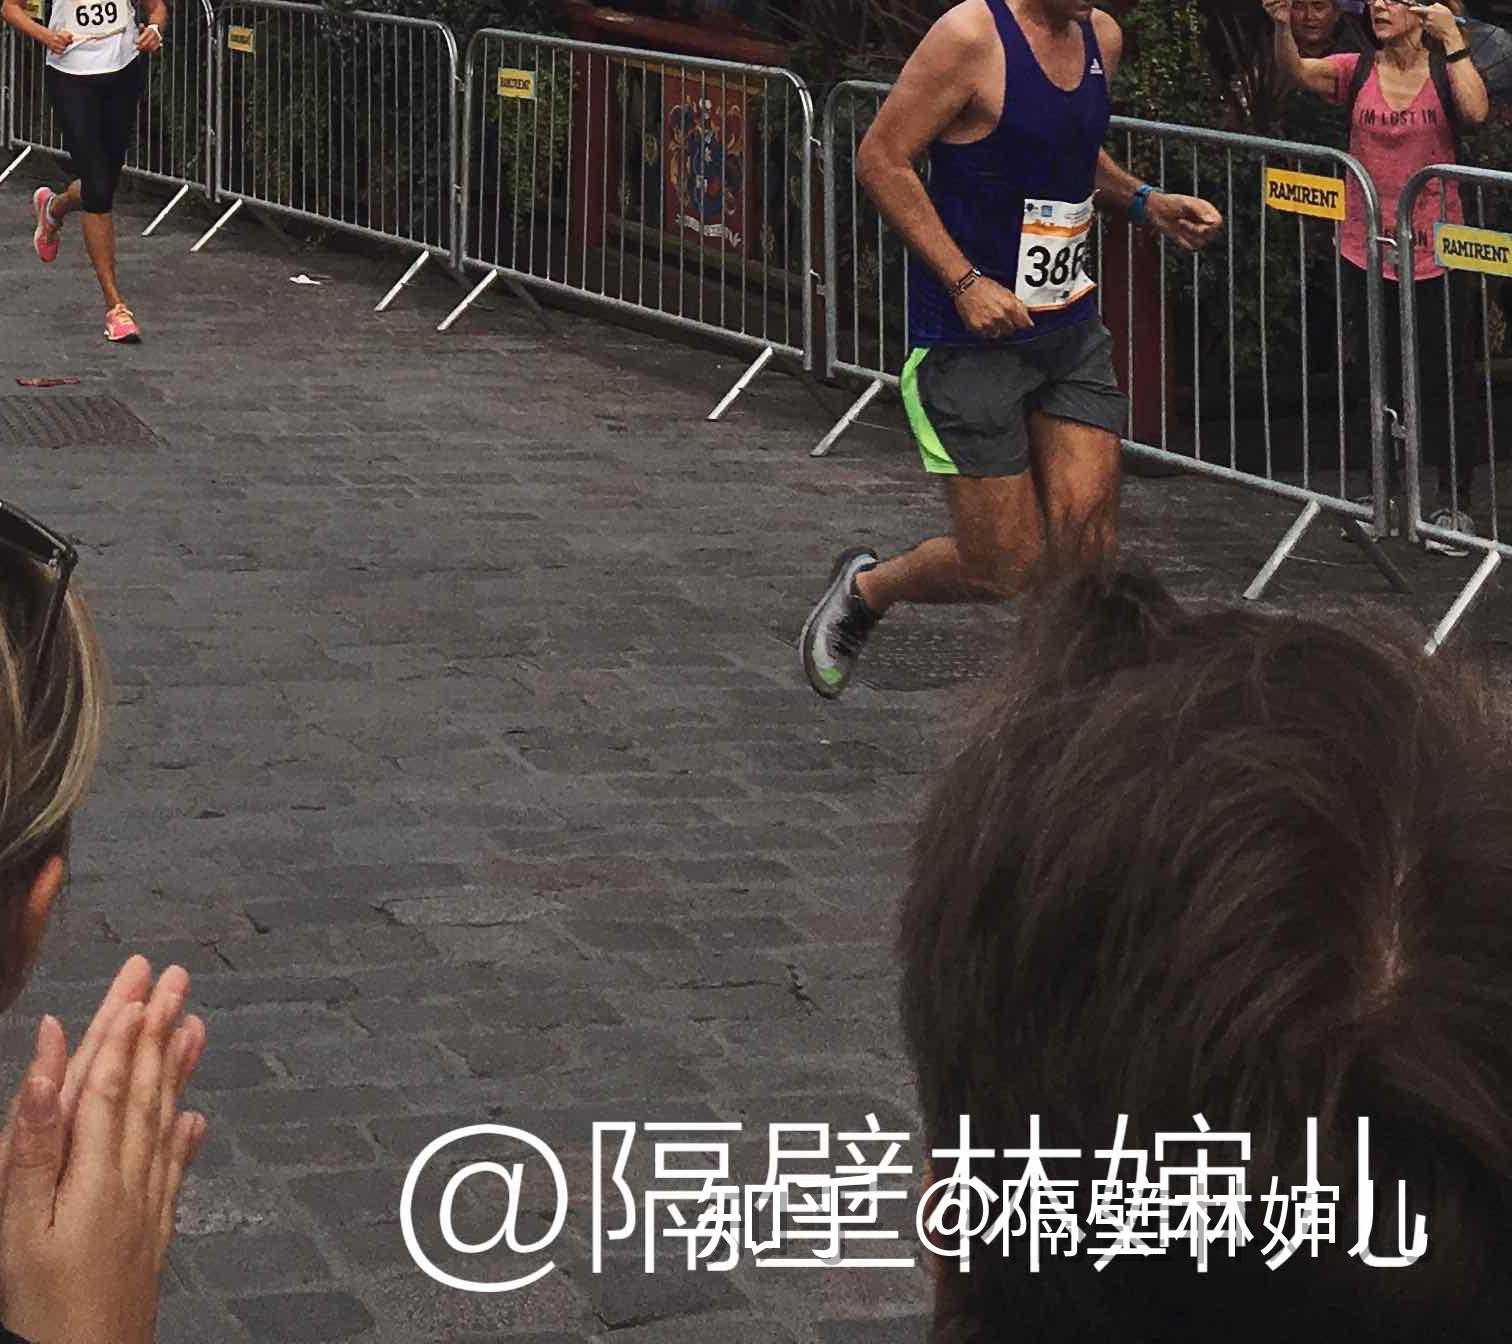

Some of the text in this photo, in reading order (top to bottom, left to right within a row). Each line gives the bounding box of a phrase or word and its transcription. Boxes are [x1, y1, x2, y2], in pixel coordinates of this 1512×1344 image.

[76, 1, 118, 26] 639
[1381, 110, 1416, 126] LOST
[1268, 180, 1339, 208] RAMIRENT
[1442, 237, 1510, 263] RAMIRENT
